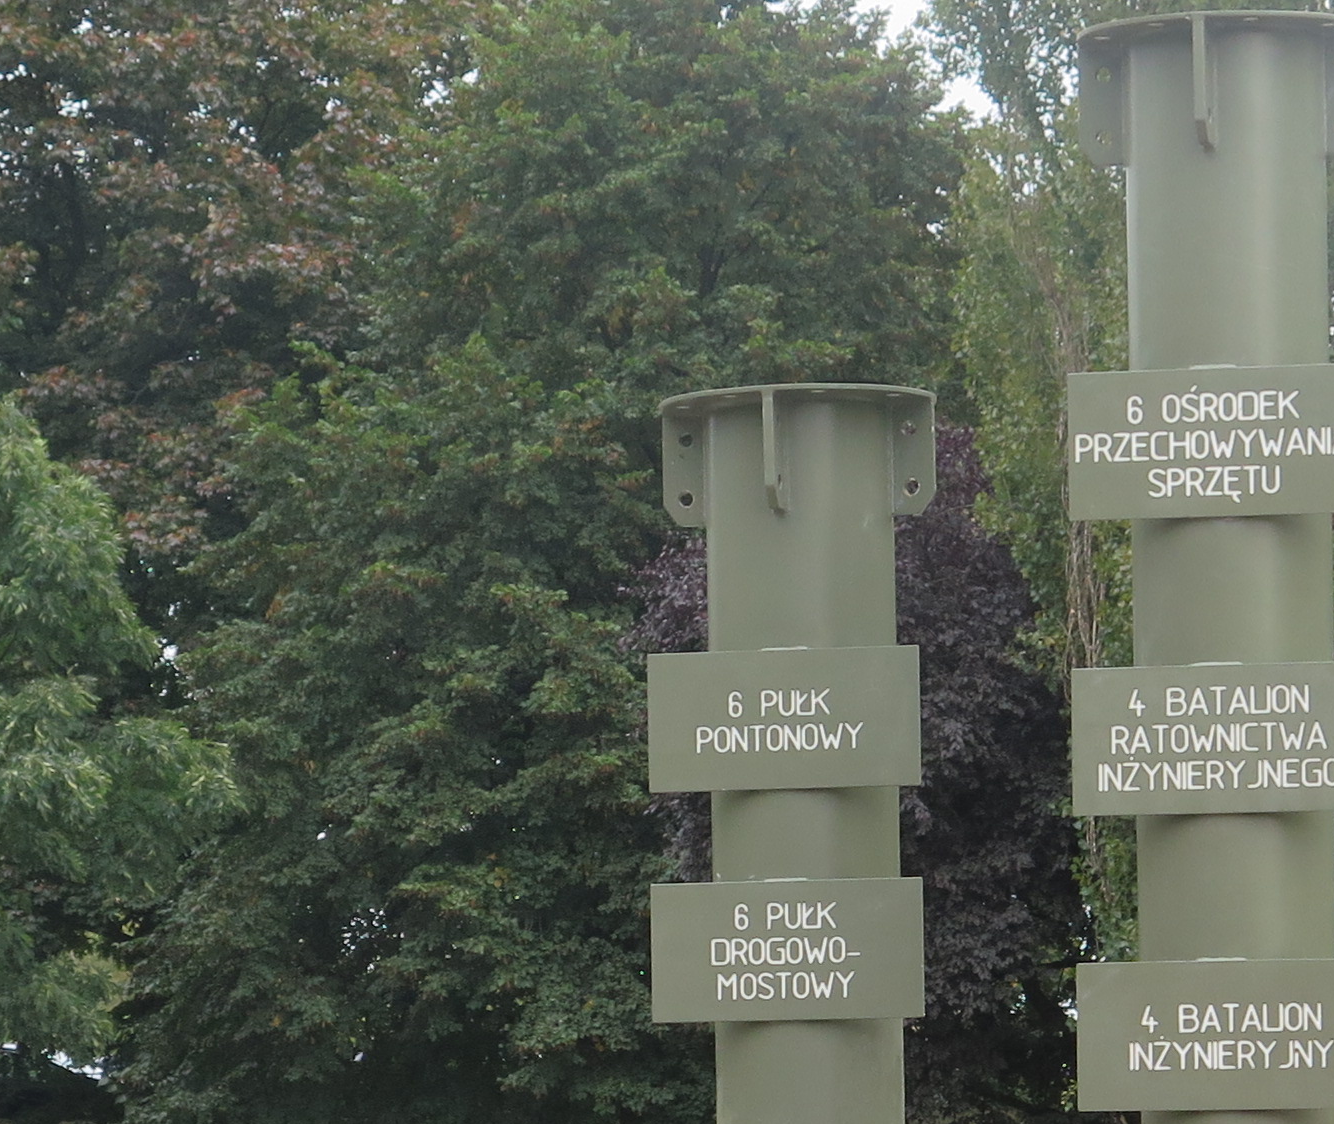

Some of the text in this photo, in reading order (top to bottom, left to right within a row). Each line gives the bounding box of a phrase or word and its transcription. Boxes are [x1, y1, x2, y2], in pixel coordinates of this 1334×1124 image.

[1127, 385, 1300, 425] 6 OŚRODEK
[1147, 464, 1282, 503] SPRZĘTU
[728, 688, 831, 718] 6 PUŁK
[1128, 684, 1310, 717] 4 BATALION
[695, 721, 864, 754] PONTONOWY
[1111, 721, 1328, 755] RATOWNICTWA
[734, 901, 837, 930] 6 PUŁK
[710, 936, 861, 966] DROGOWO-
[717, 970, 855, 1001] MOSTOWY
[1141, 1001, 1323, 1033] 4 BATALION
[1129, 1033, 1334, 1072] INŻYNIERYJNY
